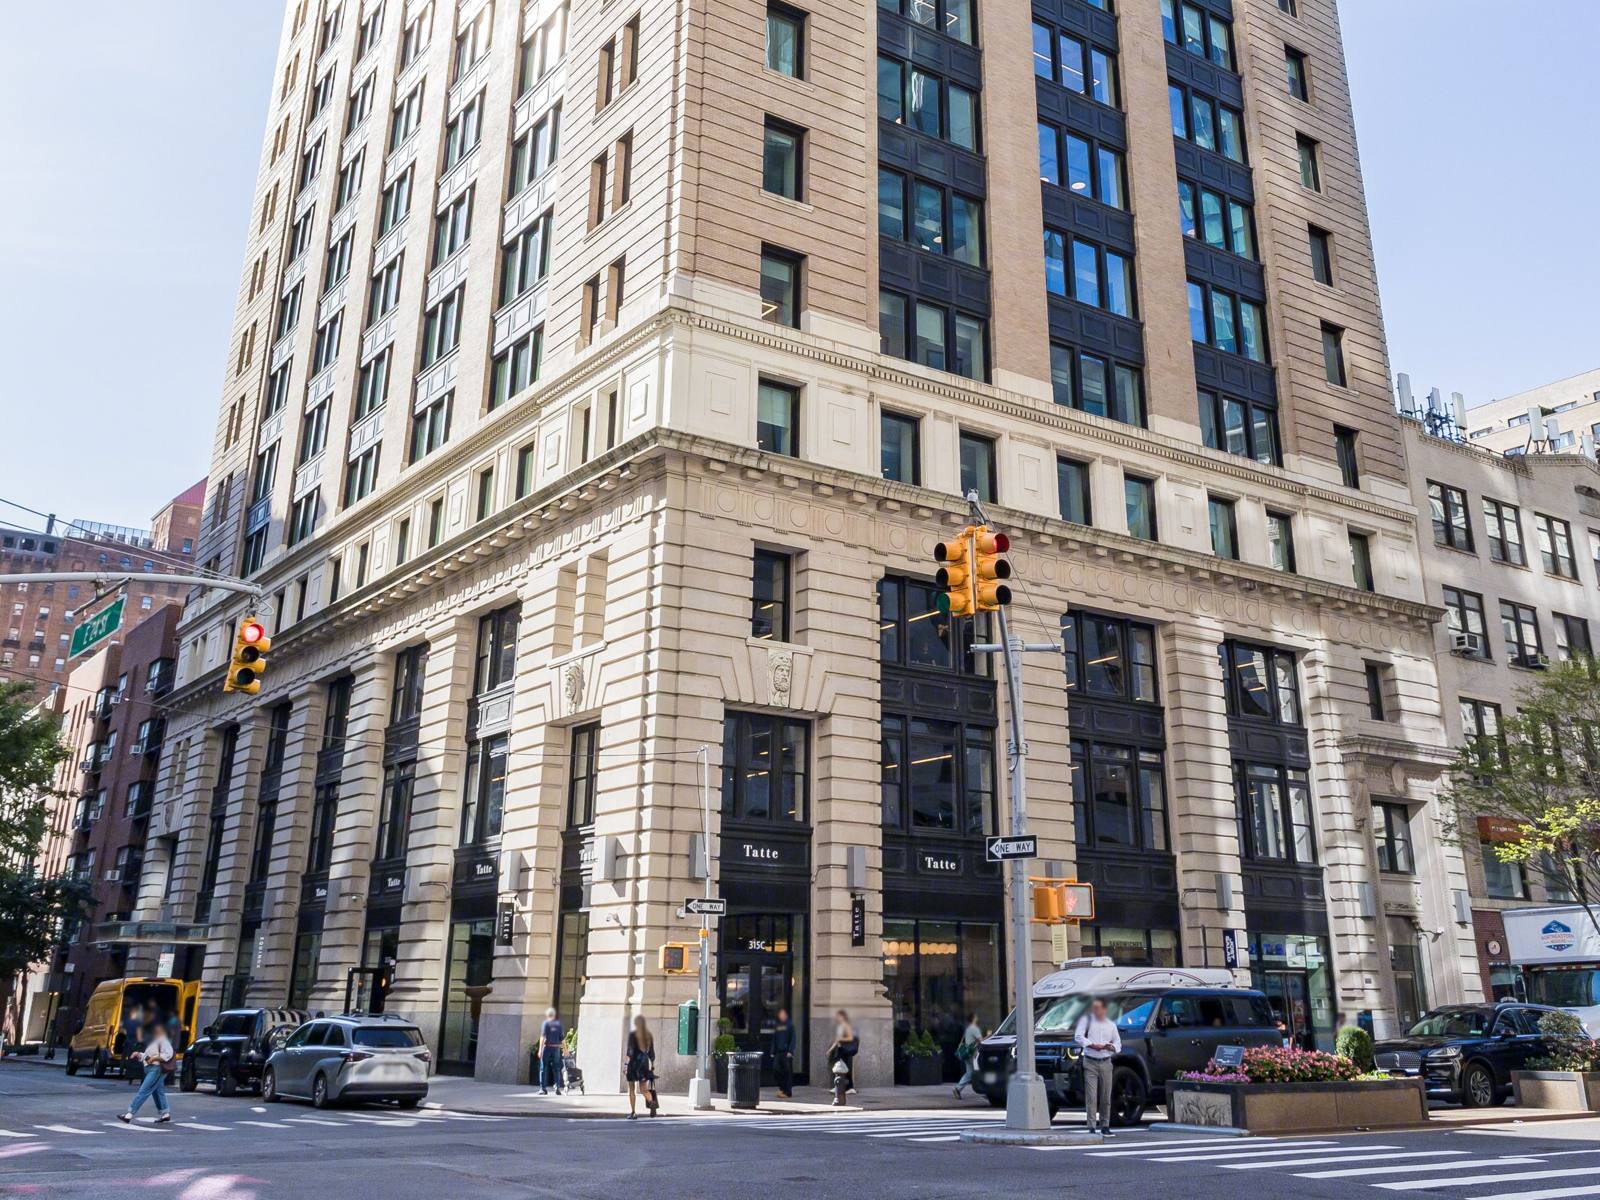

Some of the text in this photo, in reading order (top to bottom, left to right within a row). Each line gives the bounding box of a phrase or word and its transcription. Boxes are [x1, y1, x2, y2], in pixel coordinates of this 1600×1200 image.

[743, 844, 779, 859] Tatte
[994, 841, 1031, 853] ONE WAY
[475, 863, 493, 875] Tatte
[925, 856, 956, 870] Tatte
[692, 902, 704, 910] ONE
[502, 909, 512, 940] Tatte
[748, 940, 766, 950] 315C
